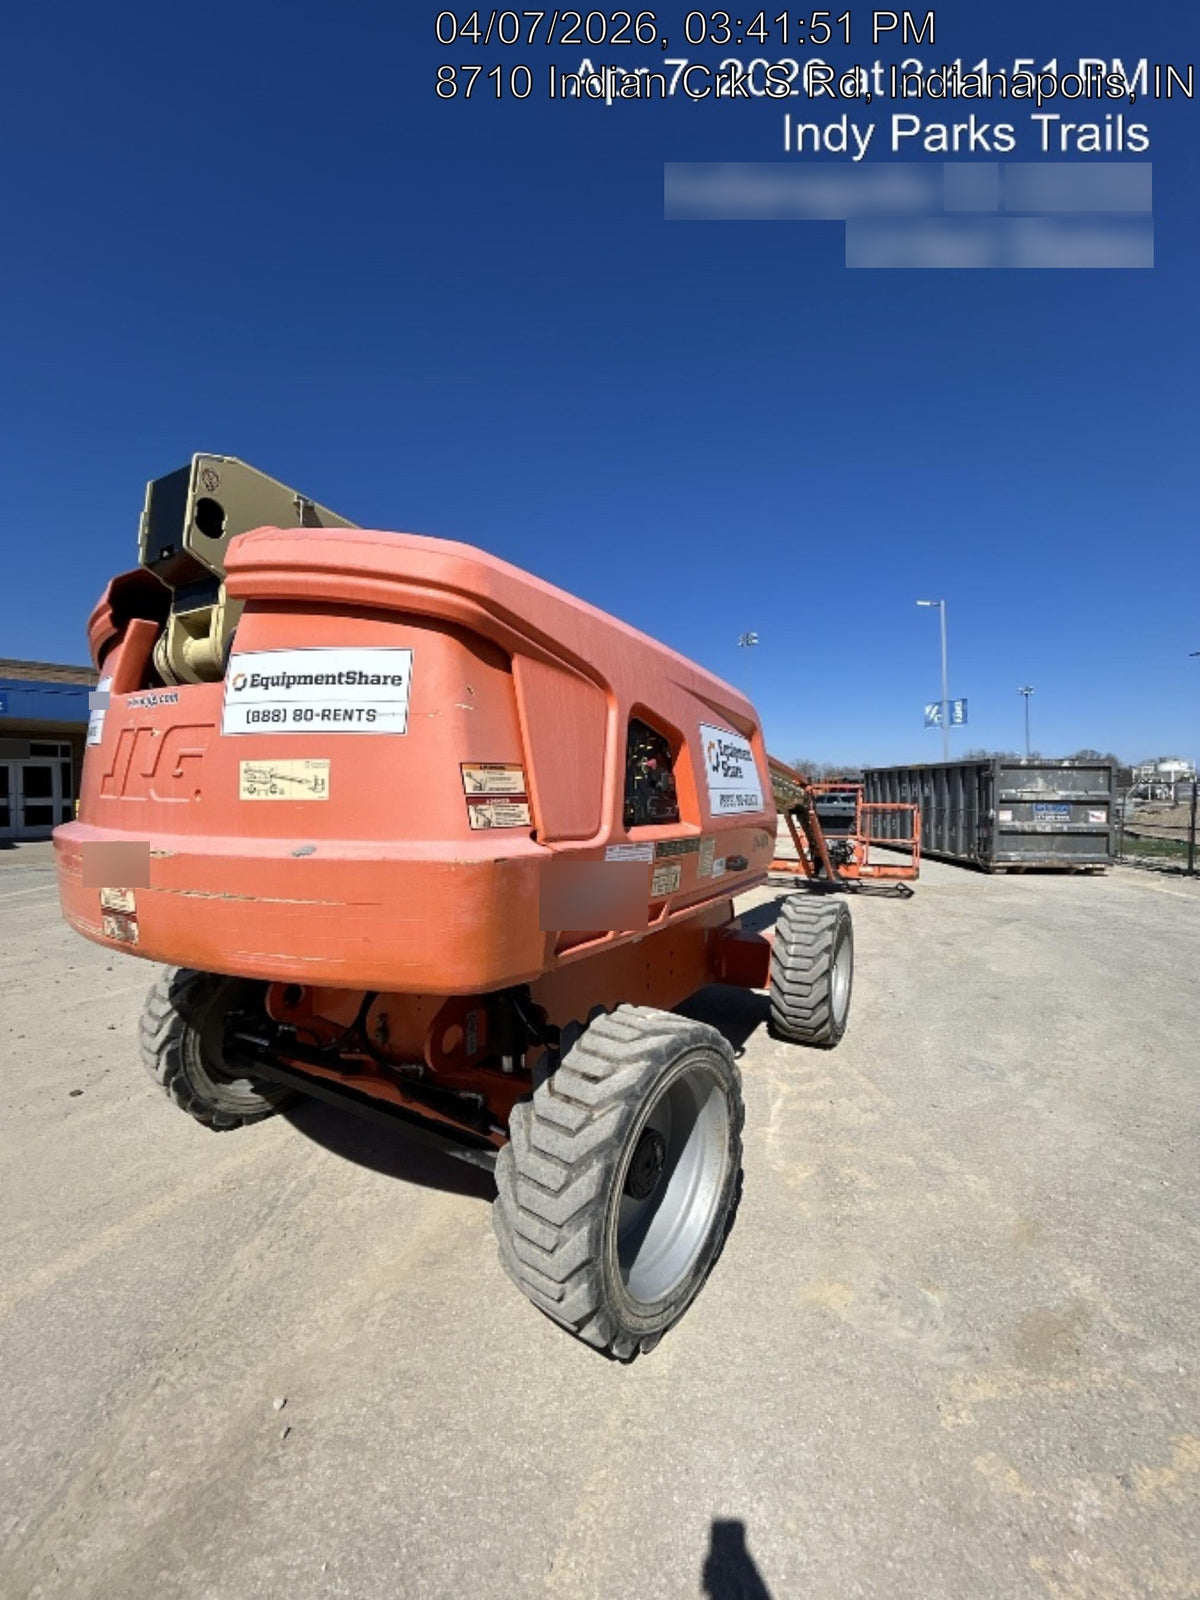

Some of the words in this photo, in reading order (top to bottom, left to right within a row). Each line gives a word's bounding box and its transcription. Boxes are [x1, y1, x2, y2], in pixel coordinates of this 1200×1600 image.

[250, 671, 403, 690] EquipmentShare
[246, 708, 287, 724] (888)
[292, 708, 378, 723] 80-RENTS
